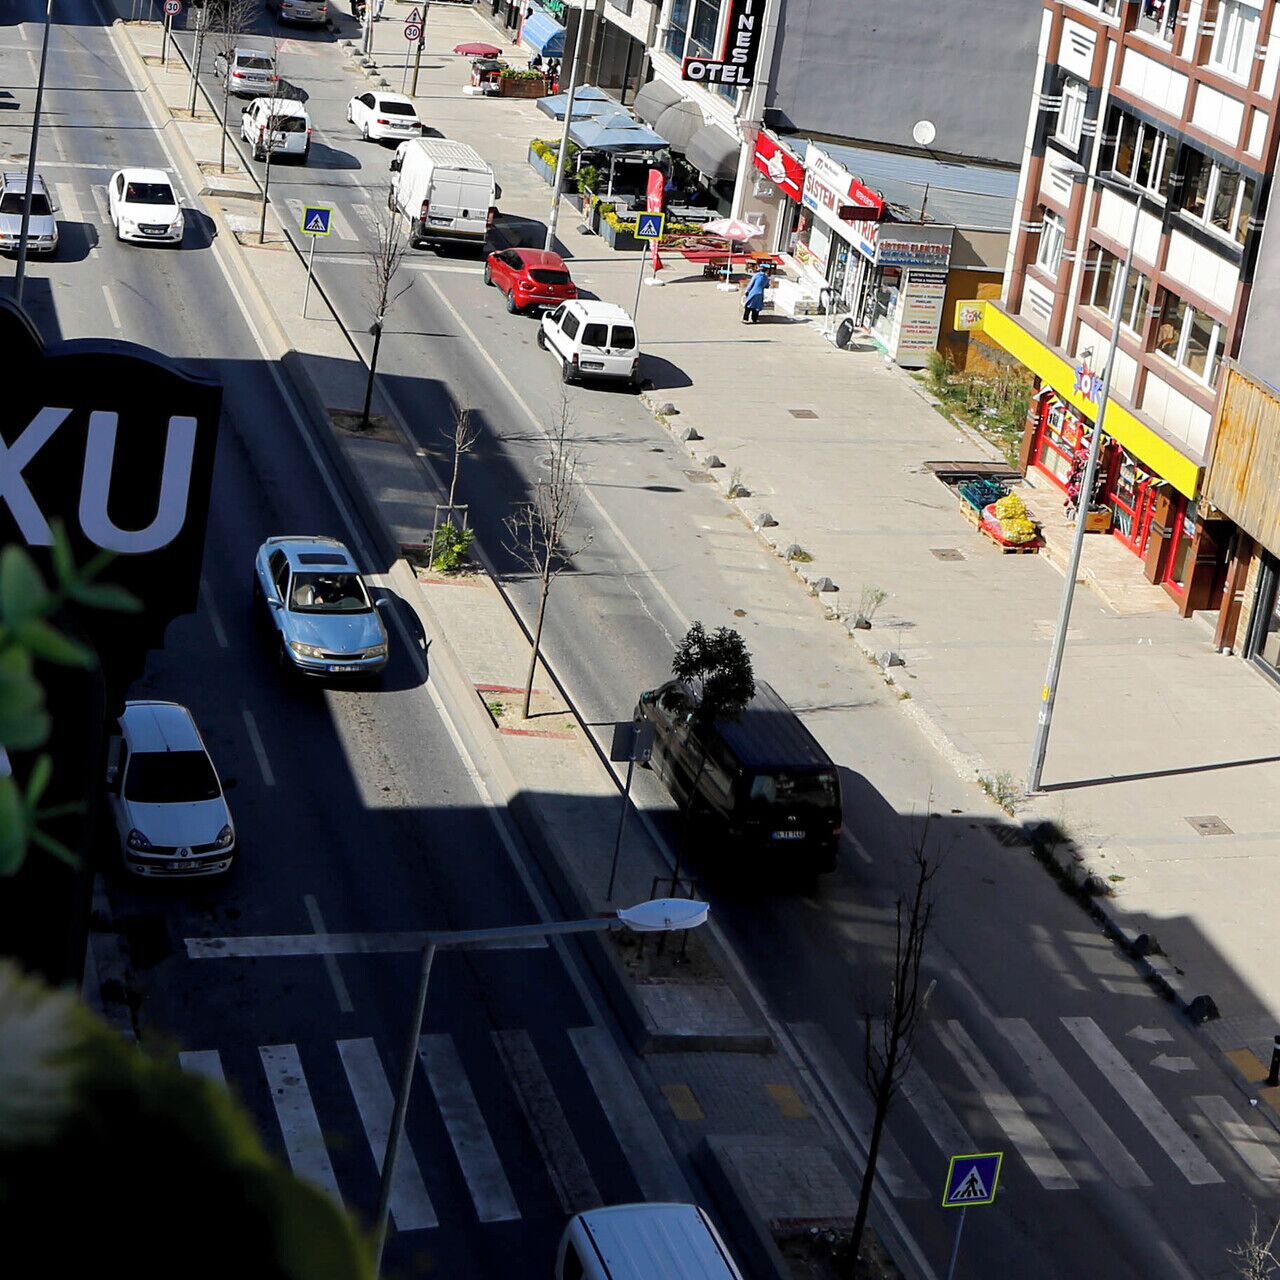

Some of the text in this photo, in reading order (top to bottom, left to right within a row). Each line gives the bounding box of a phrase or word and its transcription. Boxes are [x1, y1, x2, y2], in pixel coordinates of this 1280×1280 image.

[167, 2, 179, 12] 30
[406, 27, 419, 37] 30
[687, 62, 751, 84] OTEL
